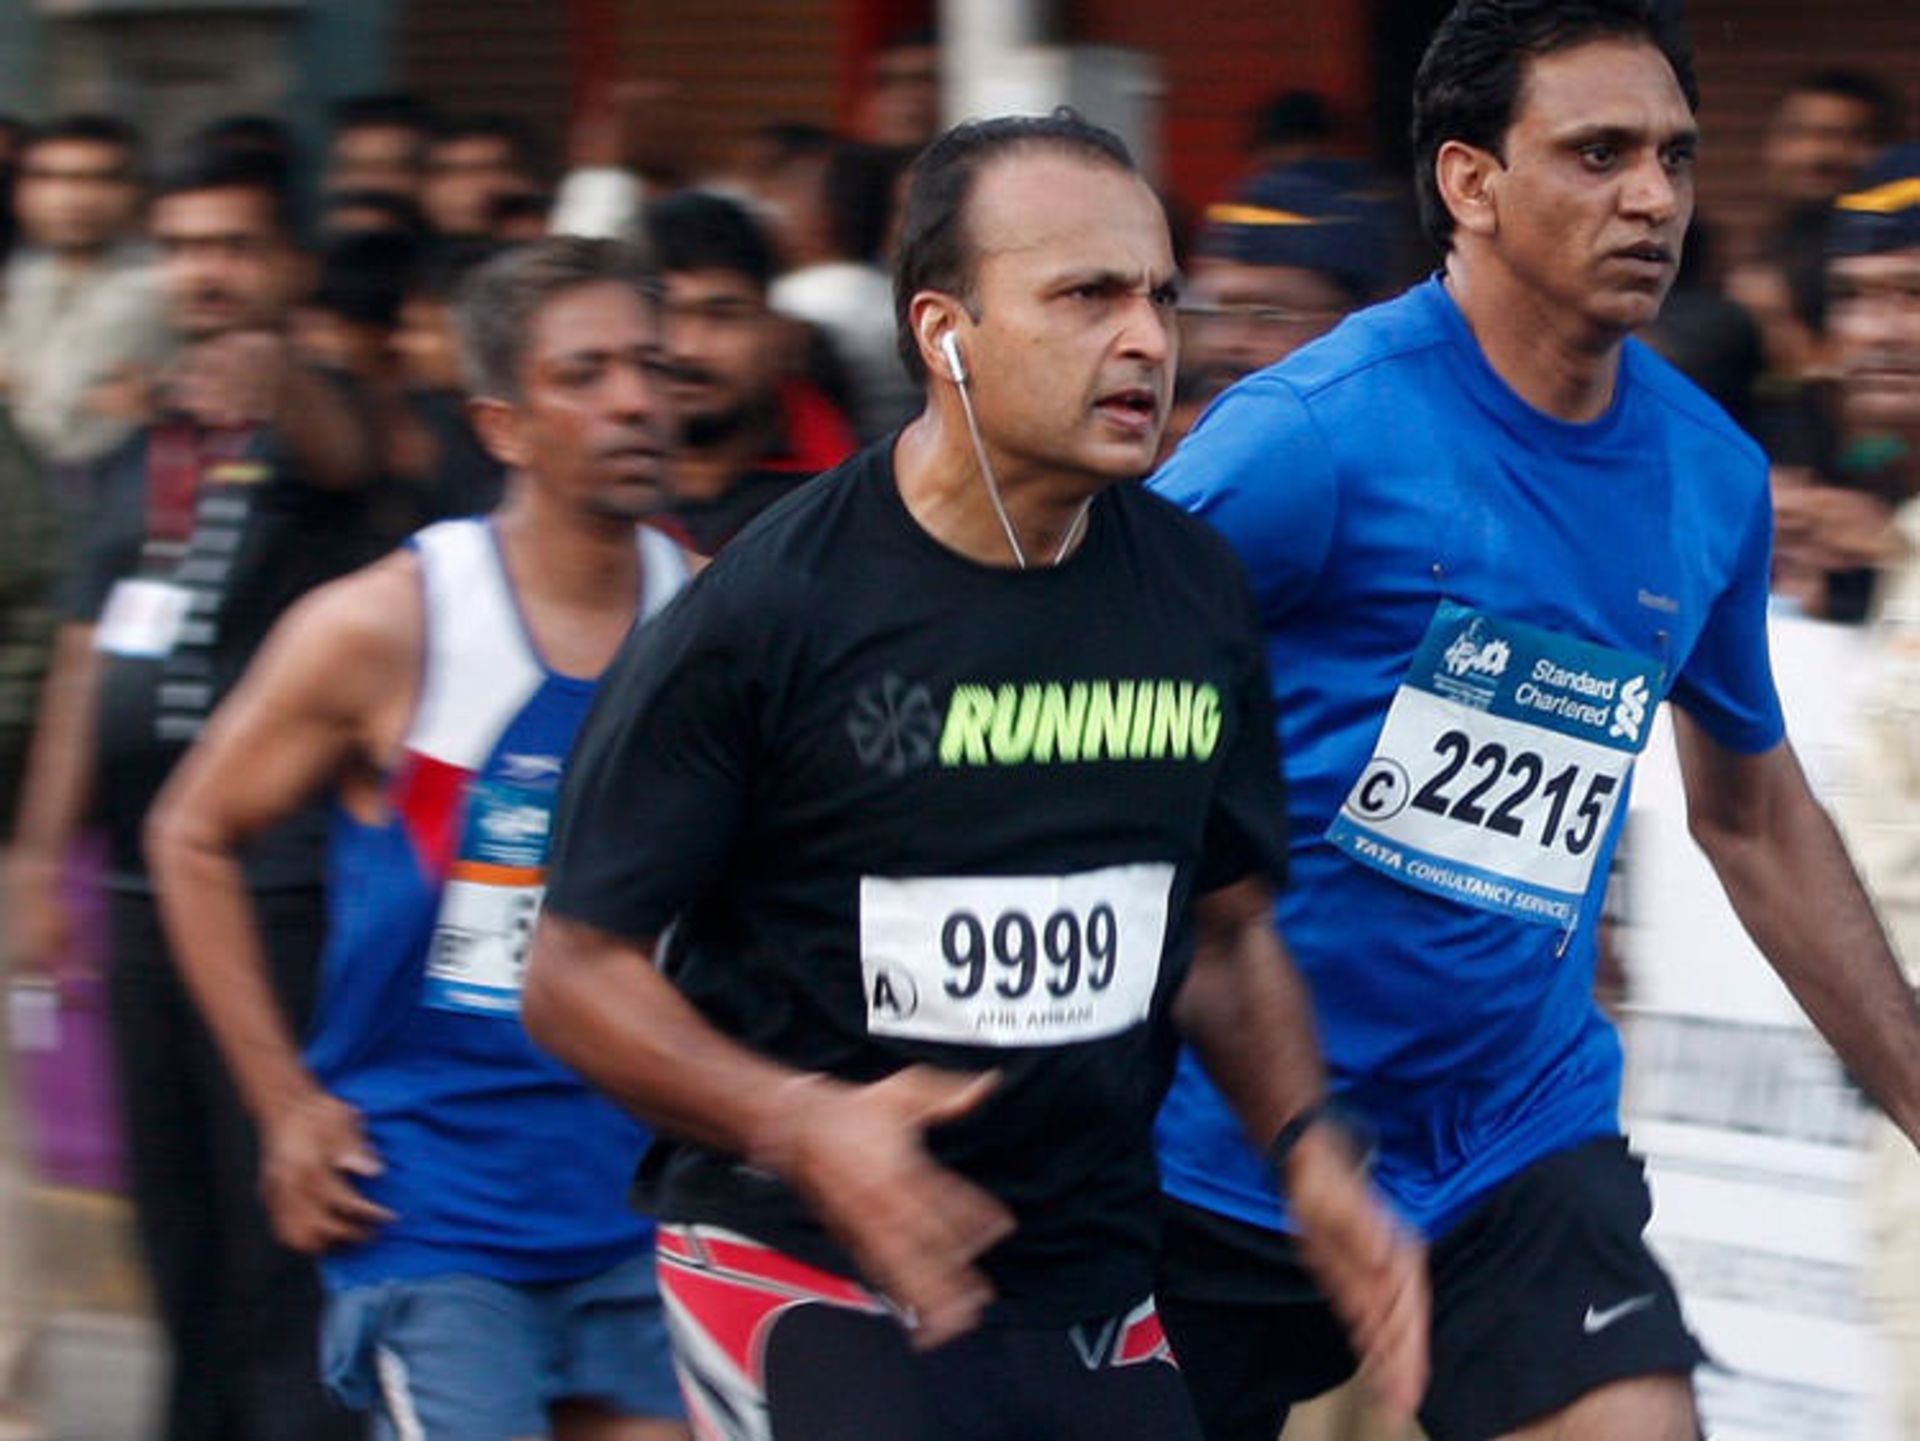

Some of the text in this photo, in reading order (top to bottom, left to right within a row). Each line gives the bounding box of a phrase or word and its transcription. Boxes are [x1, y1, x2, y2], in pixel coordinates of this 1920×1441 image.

[1515, 683, 1610, 727] Chartered
[1532, 659, 1616, 700] Standard
[939, 680, 1222, 767] RUNNING
[1359, 731, 1617, 855] C 22215
[1354, 837, 1403, 870] TATA
[1406, 859, 1516, 904] CONSULTANCY
[872, 901, 1118, 1015] A 9999
